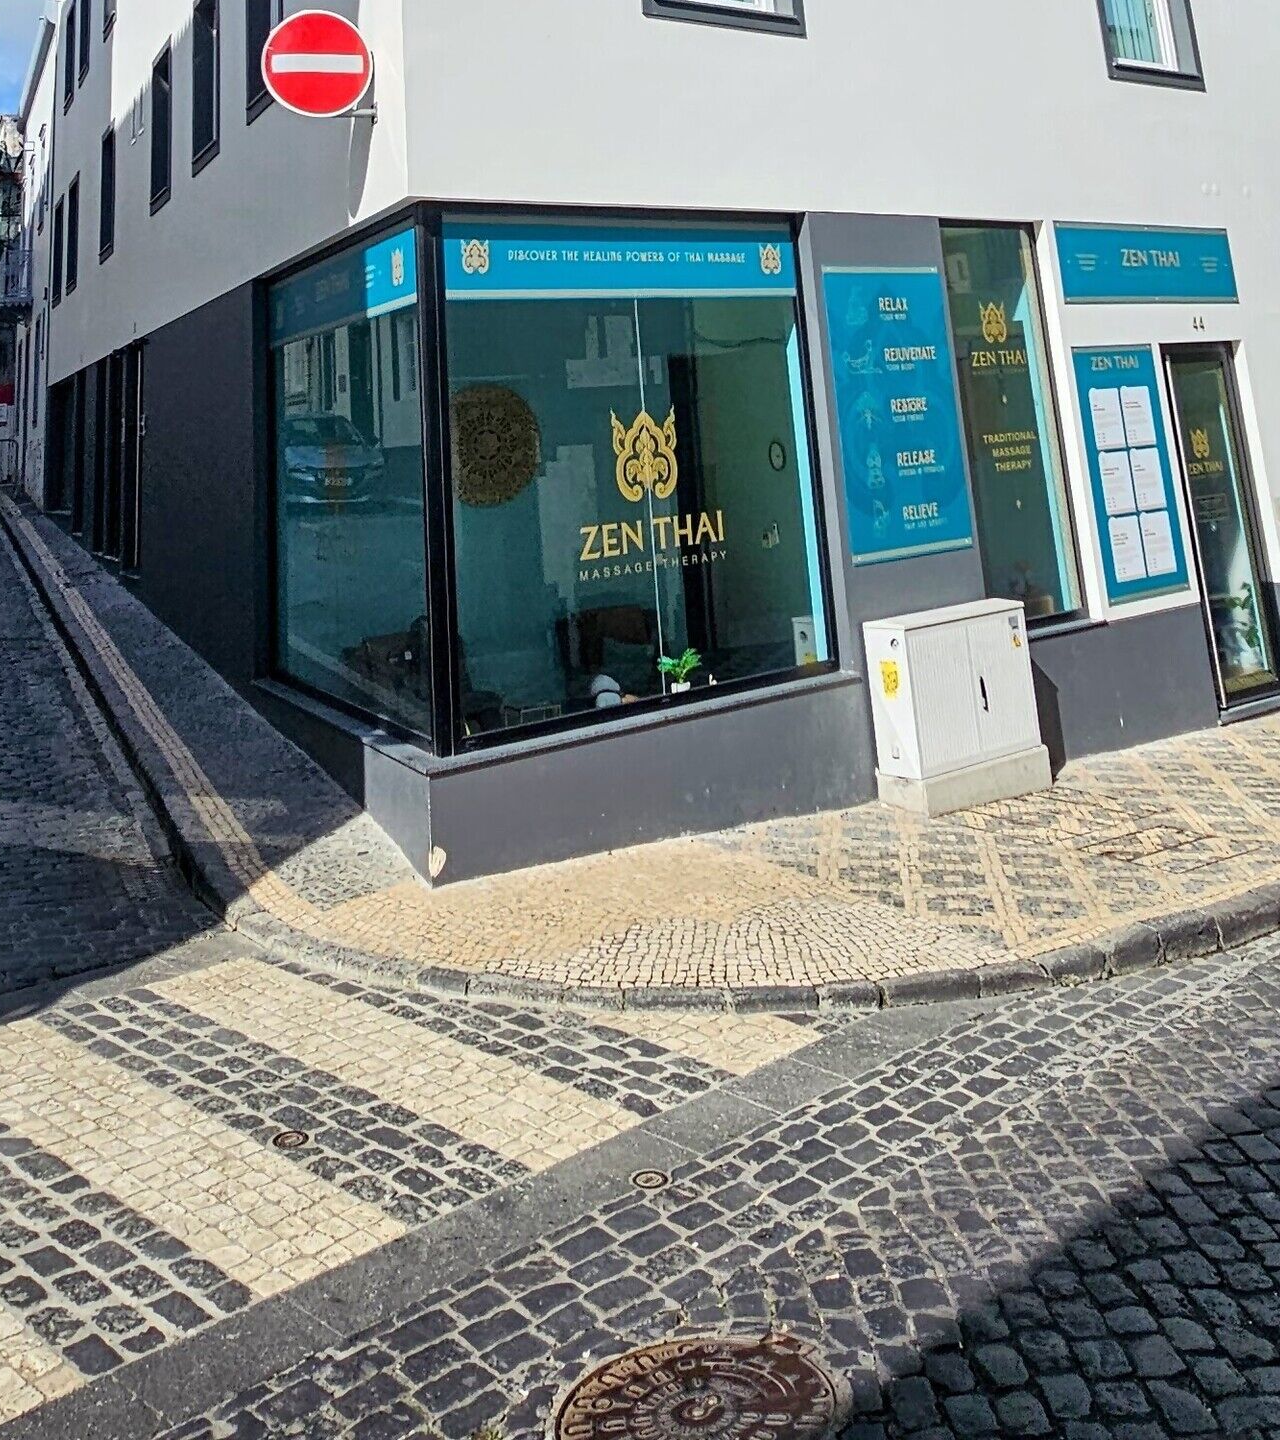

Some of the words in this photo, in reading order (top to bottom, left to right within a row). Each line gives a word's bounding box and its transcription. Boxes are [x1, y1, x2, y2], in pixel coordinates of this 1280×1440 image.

[507, 249, 558, 262] DISCOVER
[562, 250, 579, 262] THE
[583, 250, 622, 262] HEALING
[626, 250, 665, 263] POWERS
[667, 251, 681, 262] OF
[684, 251, 705, 263] THAI
[707, 251, 746, 264] MASSAGE
[1121, 248, 1148, 268] ZEN
[1149, 250, 1181, 268] THAI
[878, 297, 908, 312] RELAX
[1193, 316, 1206, 332] 44
[883, 345, 937, 362] REJUVENATE
[971, 351, 997, 367] ZEN
[997, 349, 1027, 366] THAI
[1090, 356, 1113, 371] ZEN
[1114, 354, 1140, 369] THAI
[890, 397, 928, 413] RESTORE
[982, 431, 1036, 444] TRADITIONAL
[896, 449, 936, 467] RELEASE
[992, 444, 1032, 458] MASSAGE
[994, 459, 1032, 472] THERAPY
[1189, 463, 1204, 475] ZEN
[902, 502, 938, 520] RELIEVE
[579, 519, 645, 561] ZEN
[652, 510, 725, 550] THAI
[579, 562, 653, 582] MASSAGE
[662, 550, 727, 569] THERAPY
